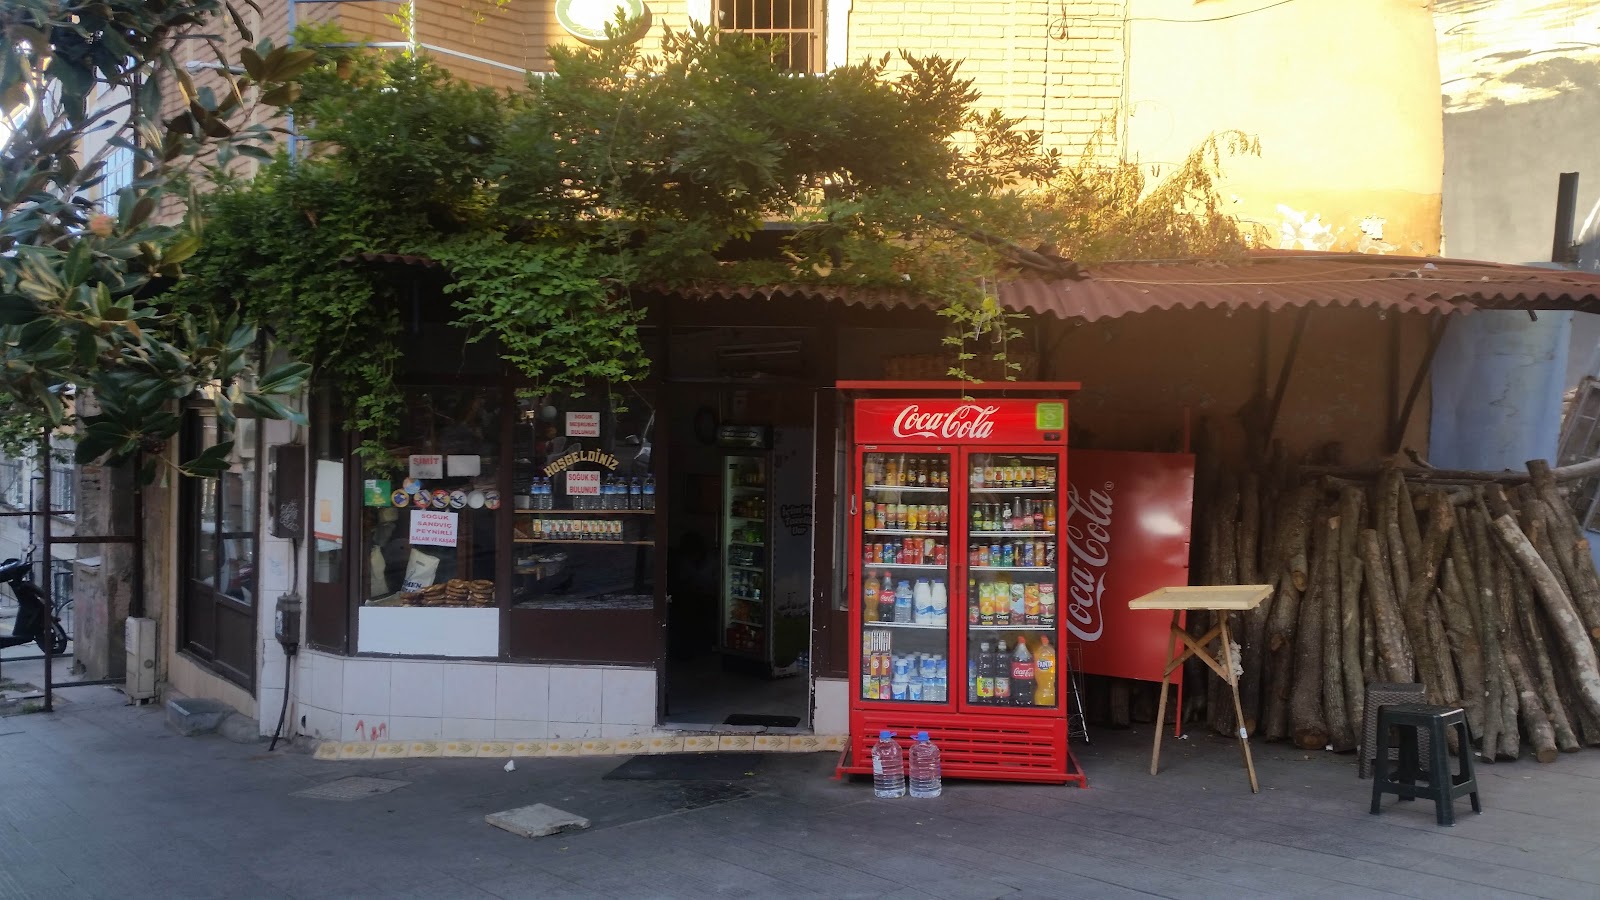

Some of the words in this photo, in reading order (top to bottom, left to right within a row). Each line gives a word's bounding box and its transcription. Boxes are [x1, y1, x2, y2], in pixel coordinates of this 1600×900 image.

[893, 404, 1000, 439] Coca-Cola
[543, 448, 620, 478] HOŞGELDİNİZ
[568, 473, 589, 481] SOĞUK
[590, 473, 599, 482] SU
[569, 486, 598, 494] BULUNUR
[1066, 481, 1114, 642] Coca-Cola
